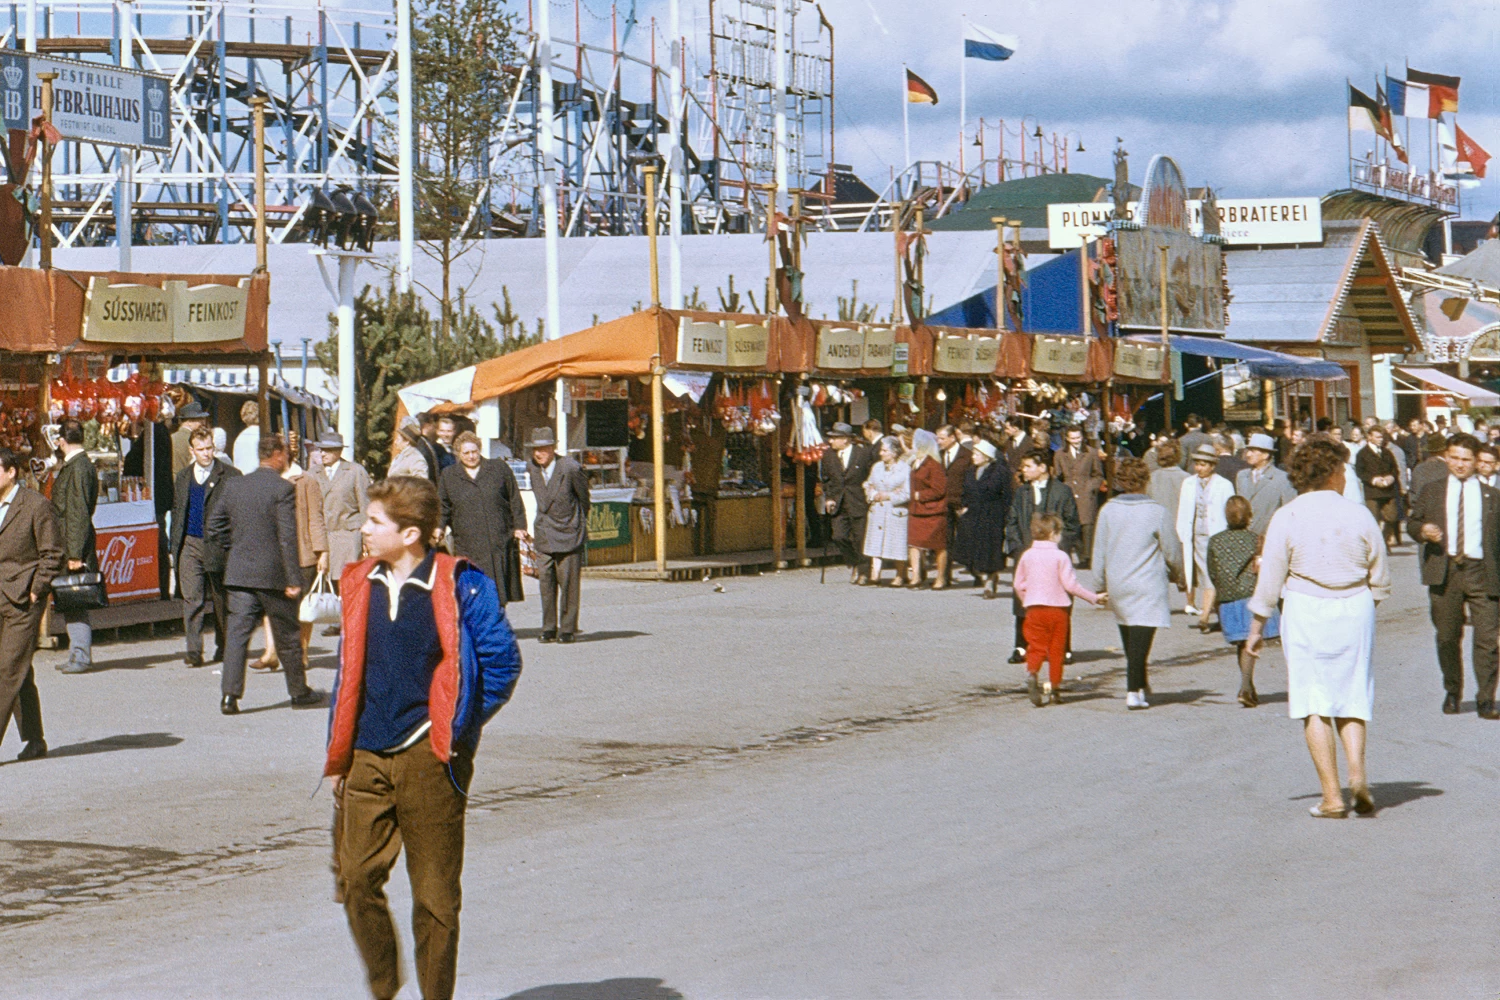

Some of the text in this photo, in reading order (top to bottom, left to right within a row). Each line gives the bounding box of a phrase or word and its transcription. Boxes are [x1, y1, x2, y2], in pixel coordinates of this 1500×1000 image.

[52, 67, 123, 90] FESTHALLE
[32, 85, 140, 123] HFBRÄUHAUS
[102, 298, 168, 323] SÜSSWAREN
[188, 300, 239, 323] FEINKOST
